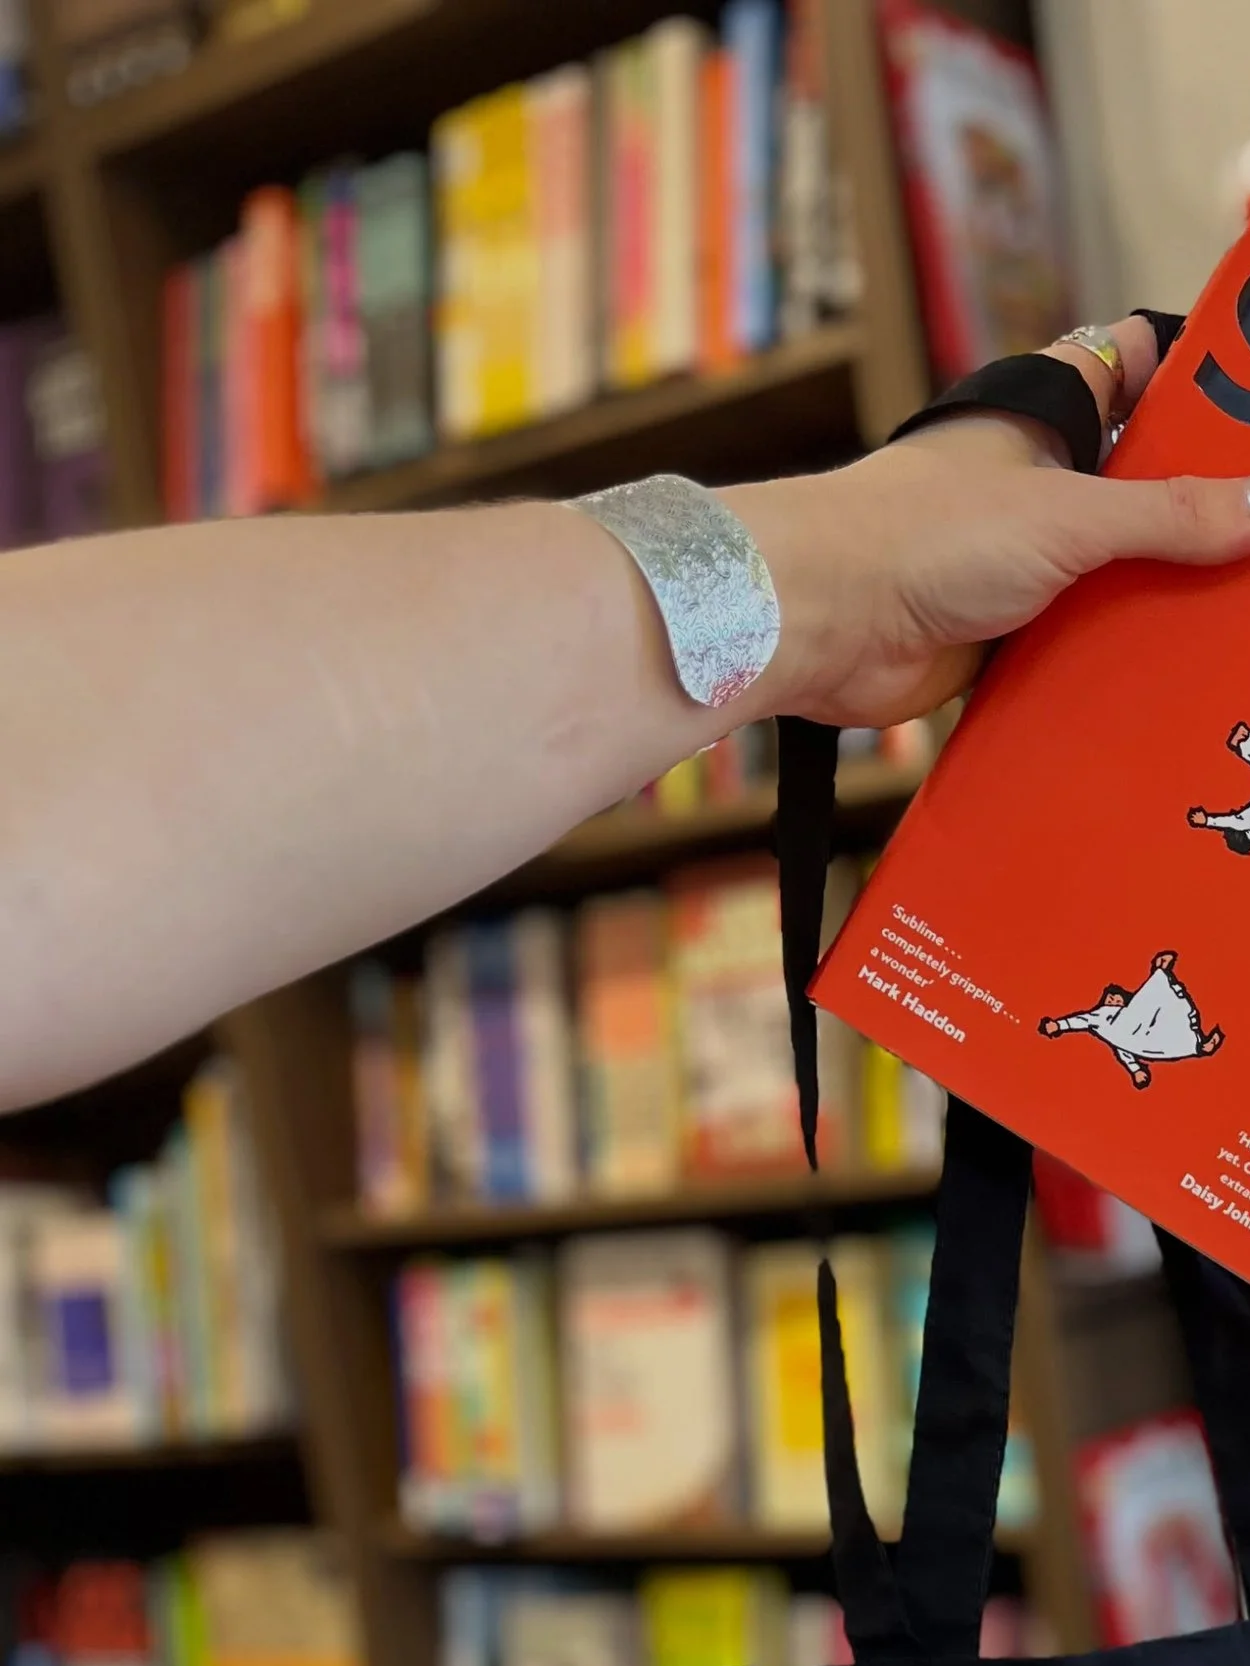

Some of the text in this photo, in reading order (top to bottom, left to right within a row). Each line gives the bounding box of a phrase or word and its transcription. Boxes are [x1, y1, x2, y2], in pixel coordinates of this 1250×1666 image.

[870, 946, 879, 957] a
[881, 928, 951, 978] completely
[949, 973, 1004, 1013] gripping
[858, 964, 966, 1043] Mark Haddon
[1217, 1147, 1240, 1168] yet.
[1180, 1173, 1224, 1210] Daisy
